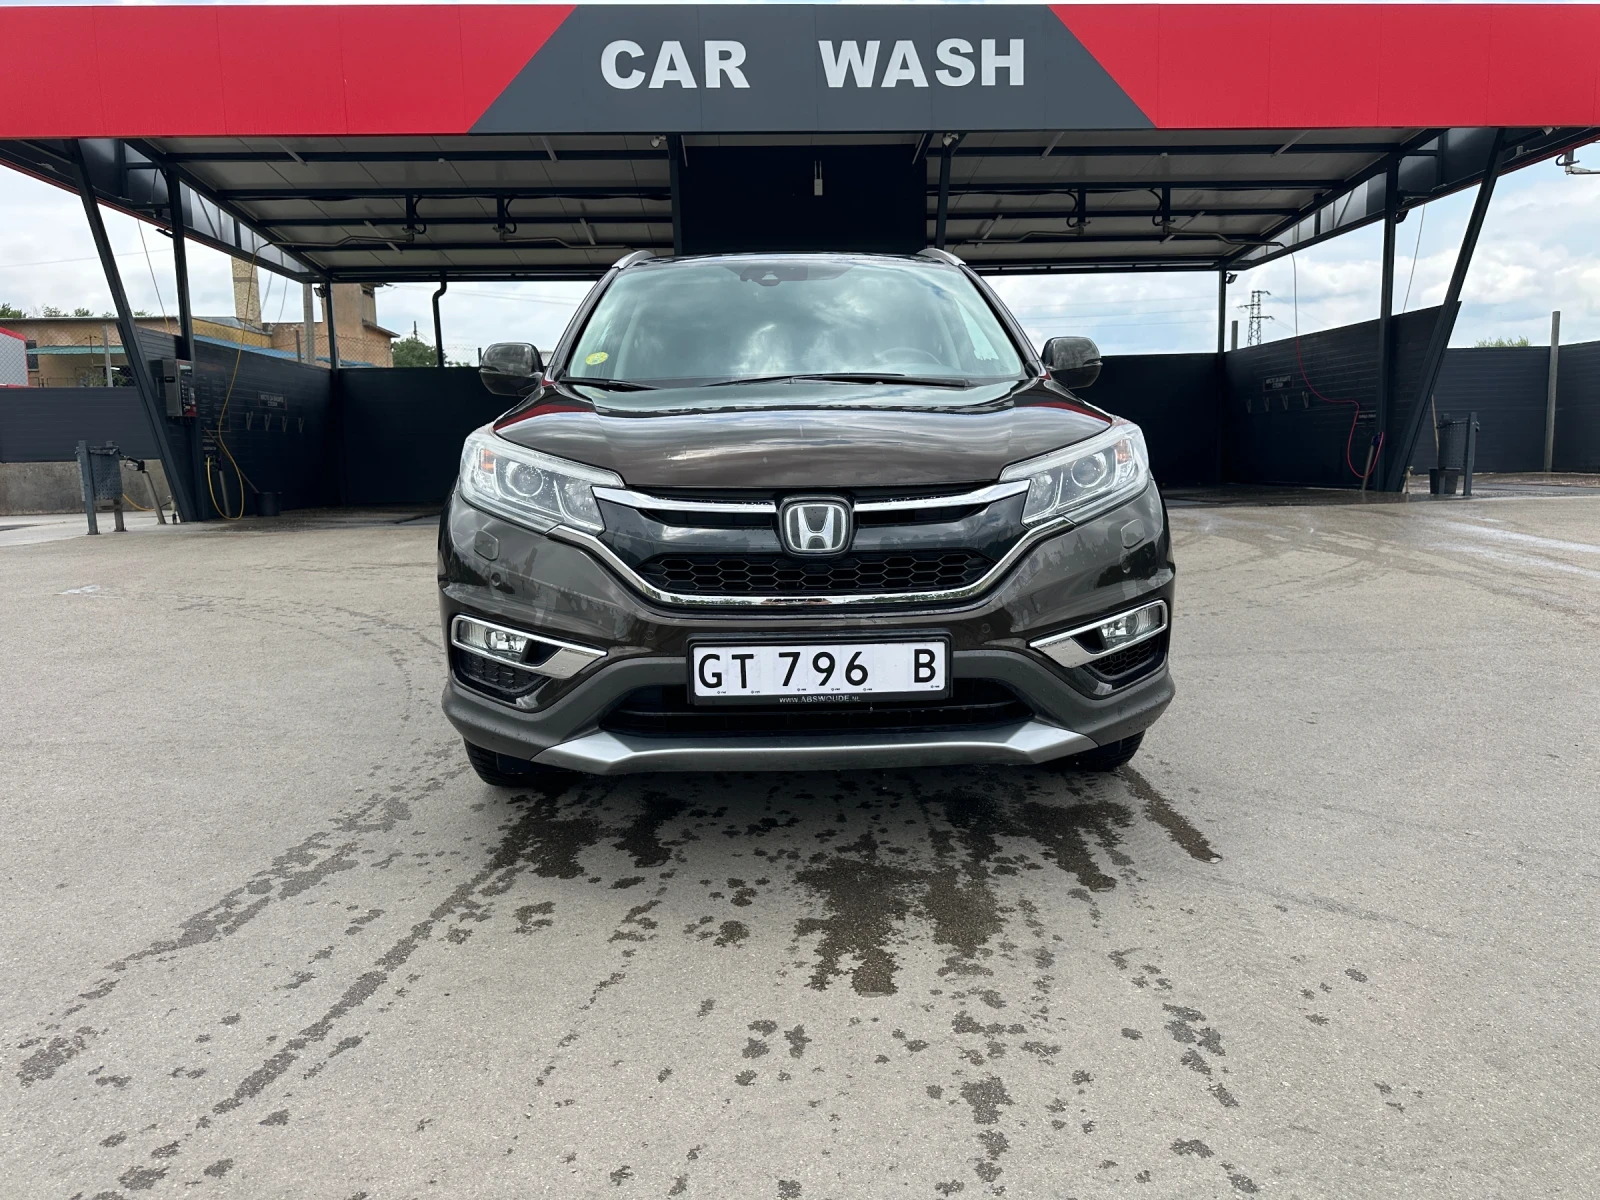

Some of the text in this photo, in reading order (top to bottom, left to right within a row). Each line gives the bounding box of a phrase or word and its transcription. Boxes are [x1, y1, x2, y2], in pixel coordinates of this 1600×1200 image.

[600, 38, 1025, 90] CAR WASH
[698, 648, 936, 689] GT 796 B
